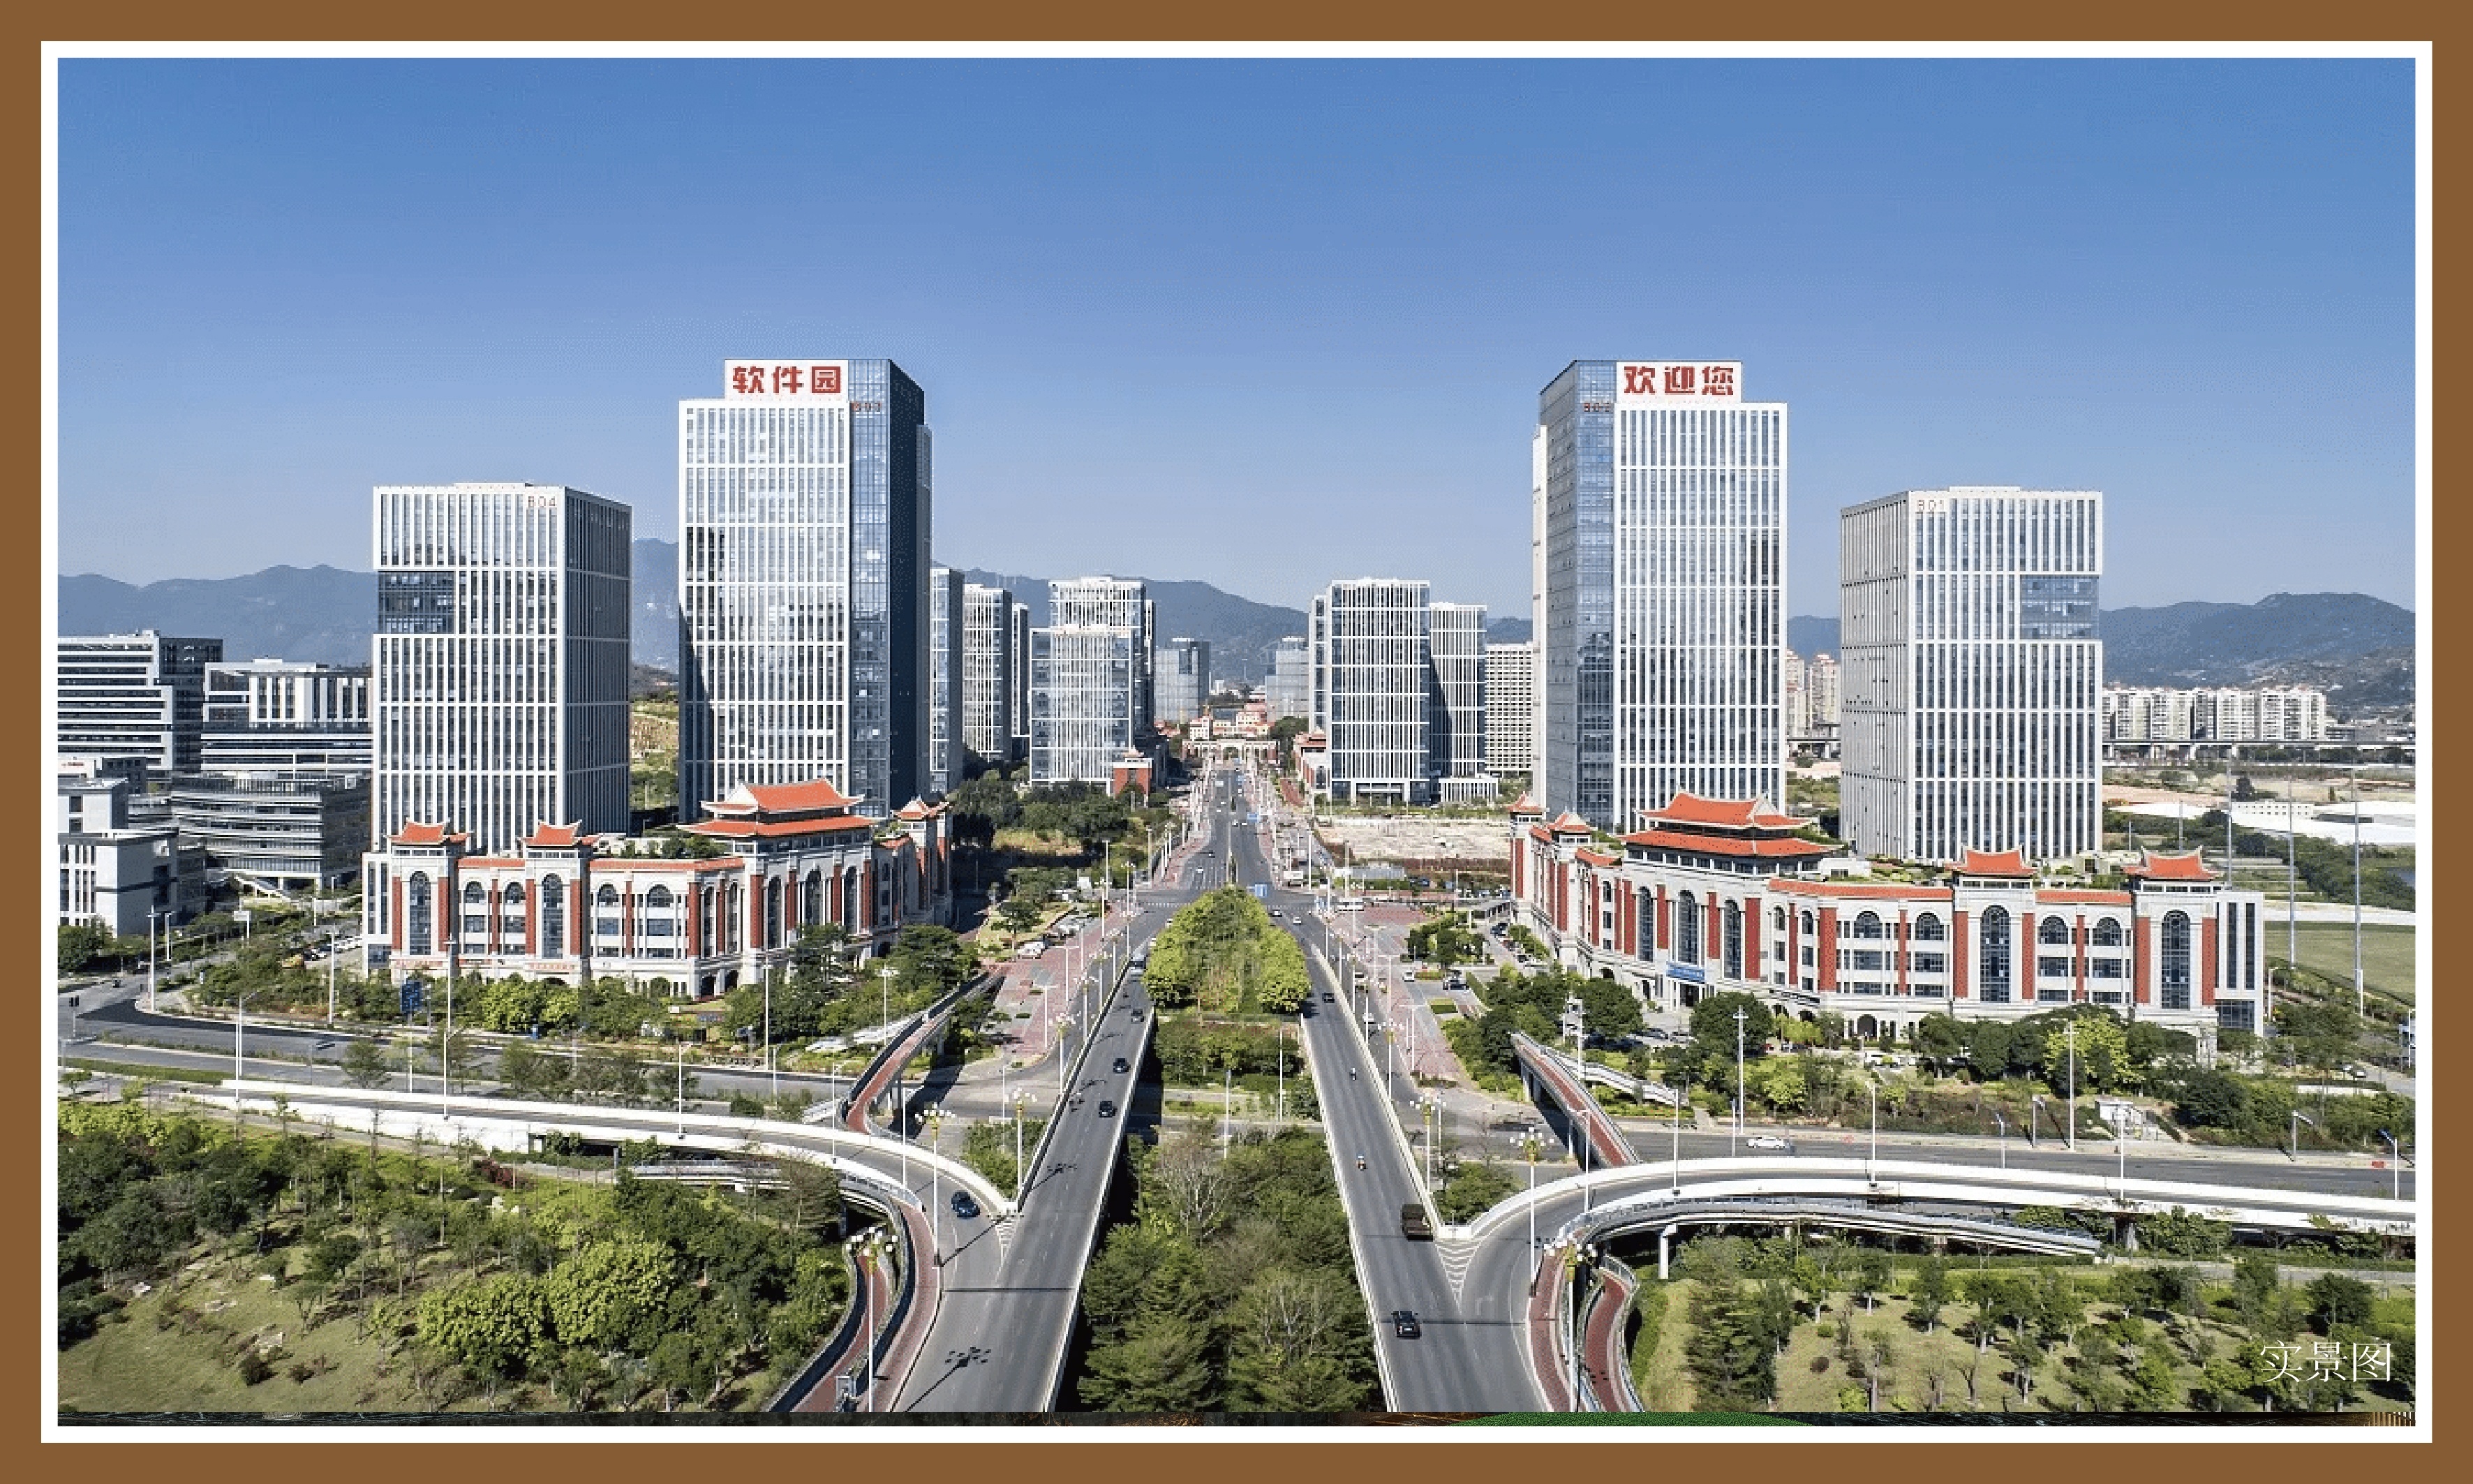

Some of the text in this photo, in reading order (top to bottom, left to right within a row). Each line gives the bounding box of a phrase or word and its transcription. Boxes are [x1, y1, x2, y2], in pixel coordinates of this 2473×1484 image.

[732, 366, 842, 394] 软件园
[1624, 366, 1735, 396] 欢迎您
